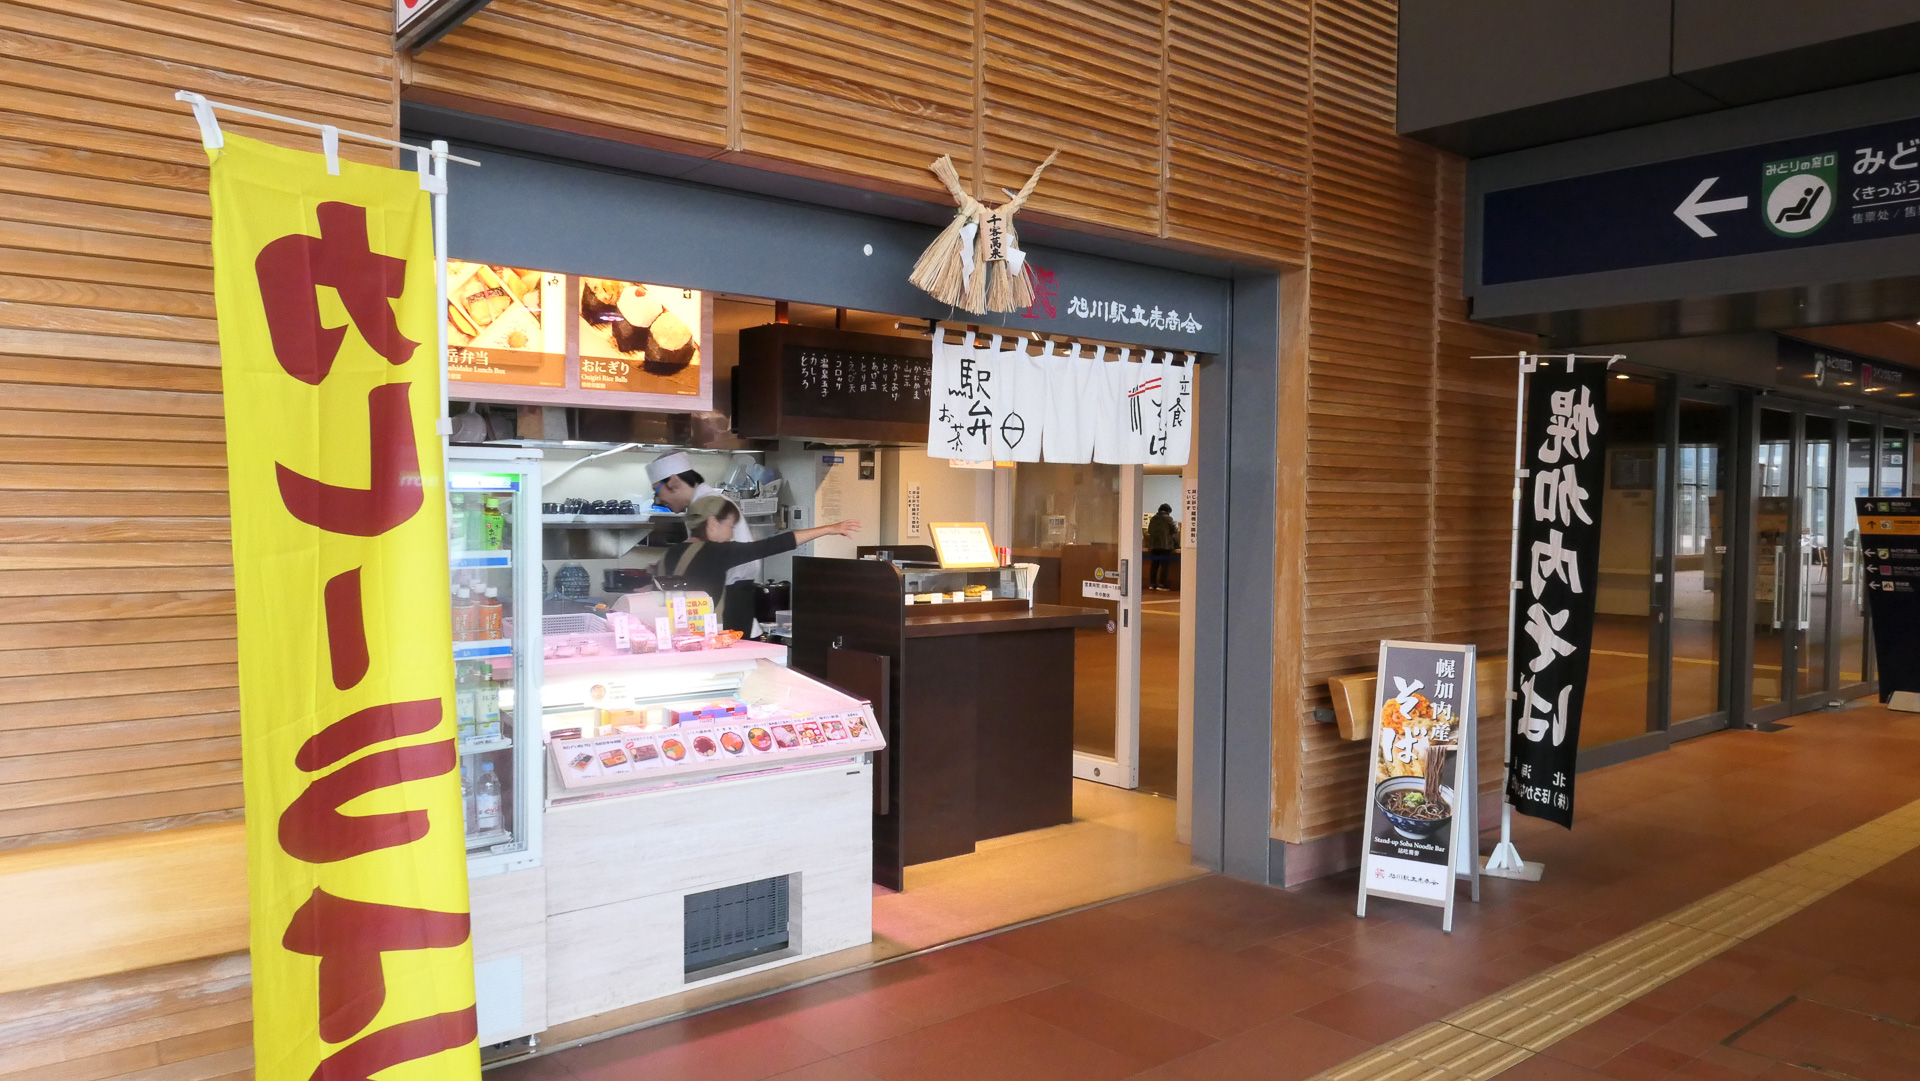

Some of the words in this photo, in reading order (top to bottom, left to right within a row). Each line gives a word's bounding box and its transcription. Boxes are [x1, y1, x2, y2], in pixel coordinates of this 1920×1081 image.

[1766, 154, 1834, 176] みどりの窓口
[1067, 296, 1203, 334] 旭川駅立売商会
[473, 366, 493, 375] Lunch
[581, 374, 602, 383] Onigiri
[582, 360, 630, 376] おにぎり
[949, 359, 993, 446] 駅弁
[939, 403, 965, 453] お茶
[1430, 658, 1456, 742] 幌加内産
[1382, 676, 1428, 765] そば
[1374, 836, 1399, 847] Stand-up
[1399, 839, 1413, 848] Soba
[1413, 842, 1435, 851] Noodle
[1434, 843, 1446, 853] Bar
